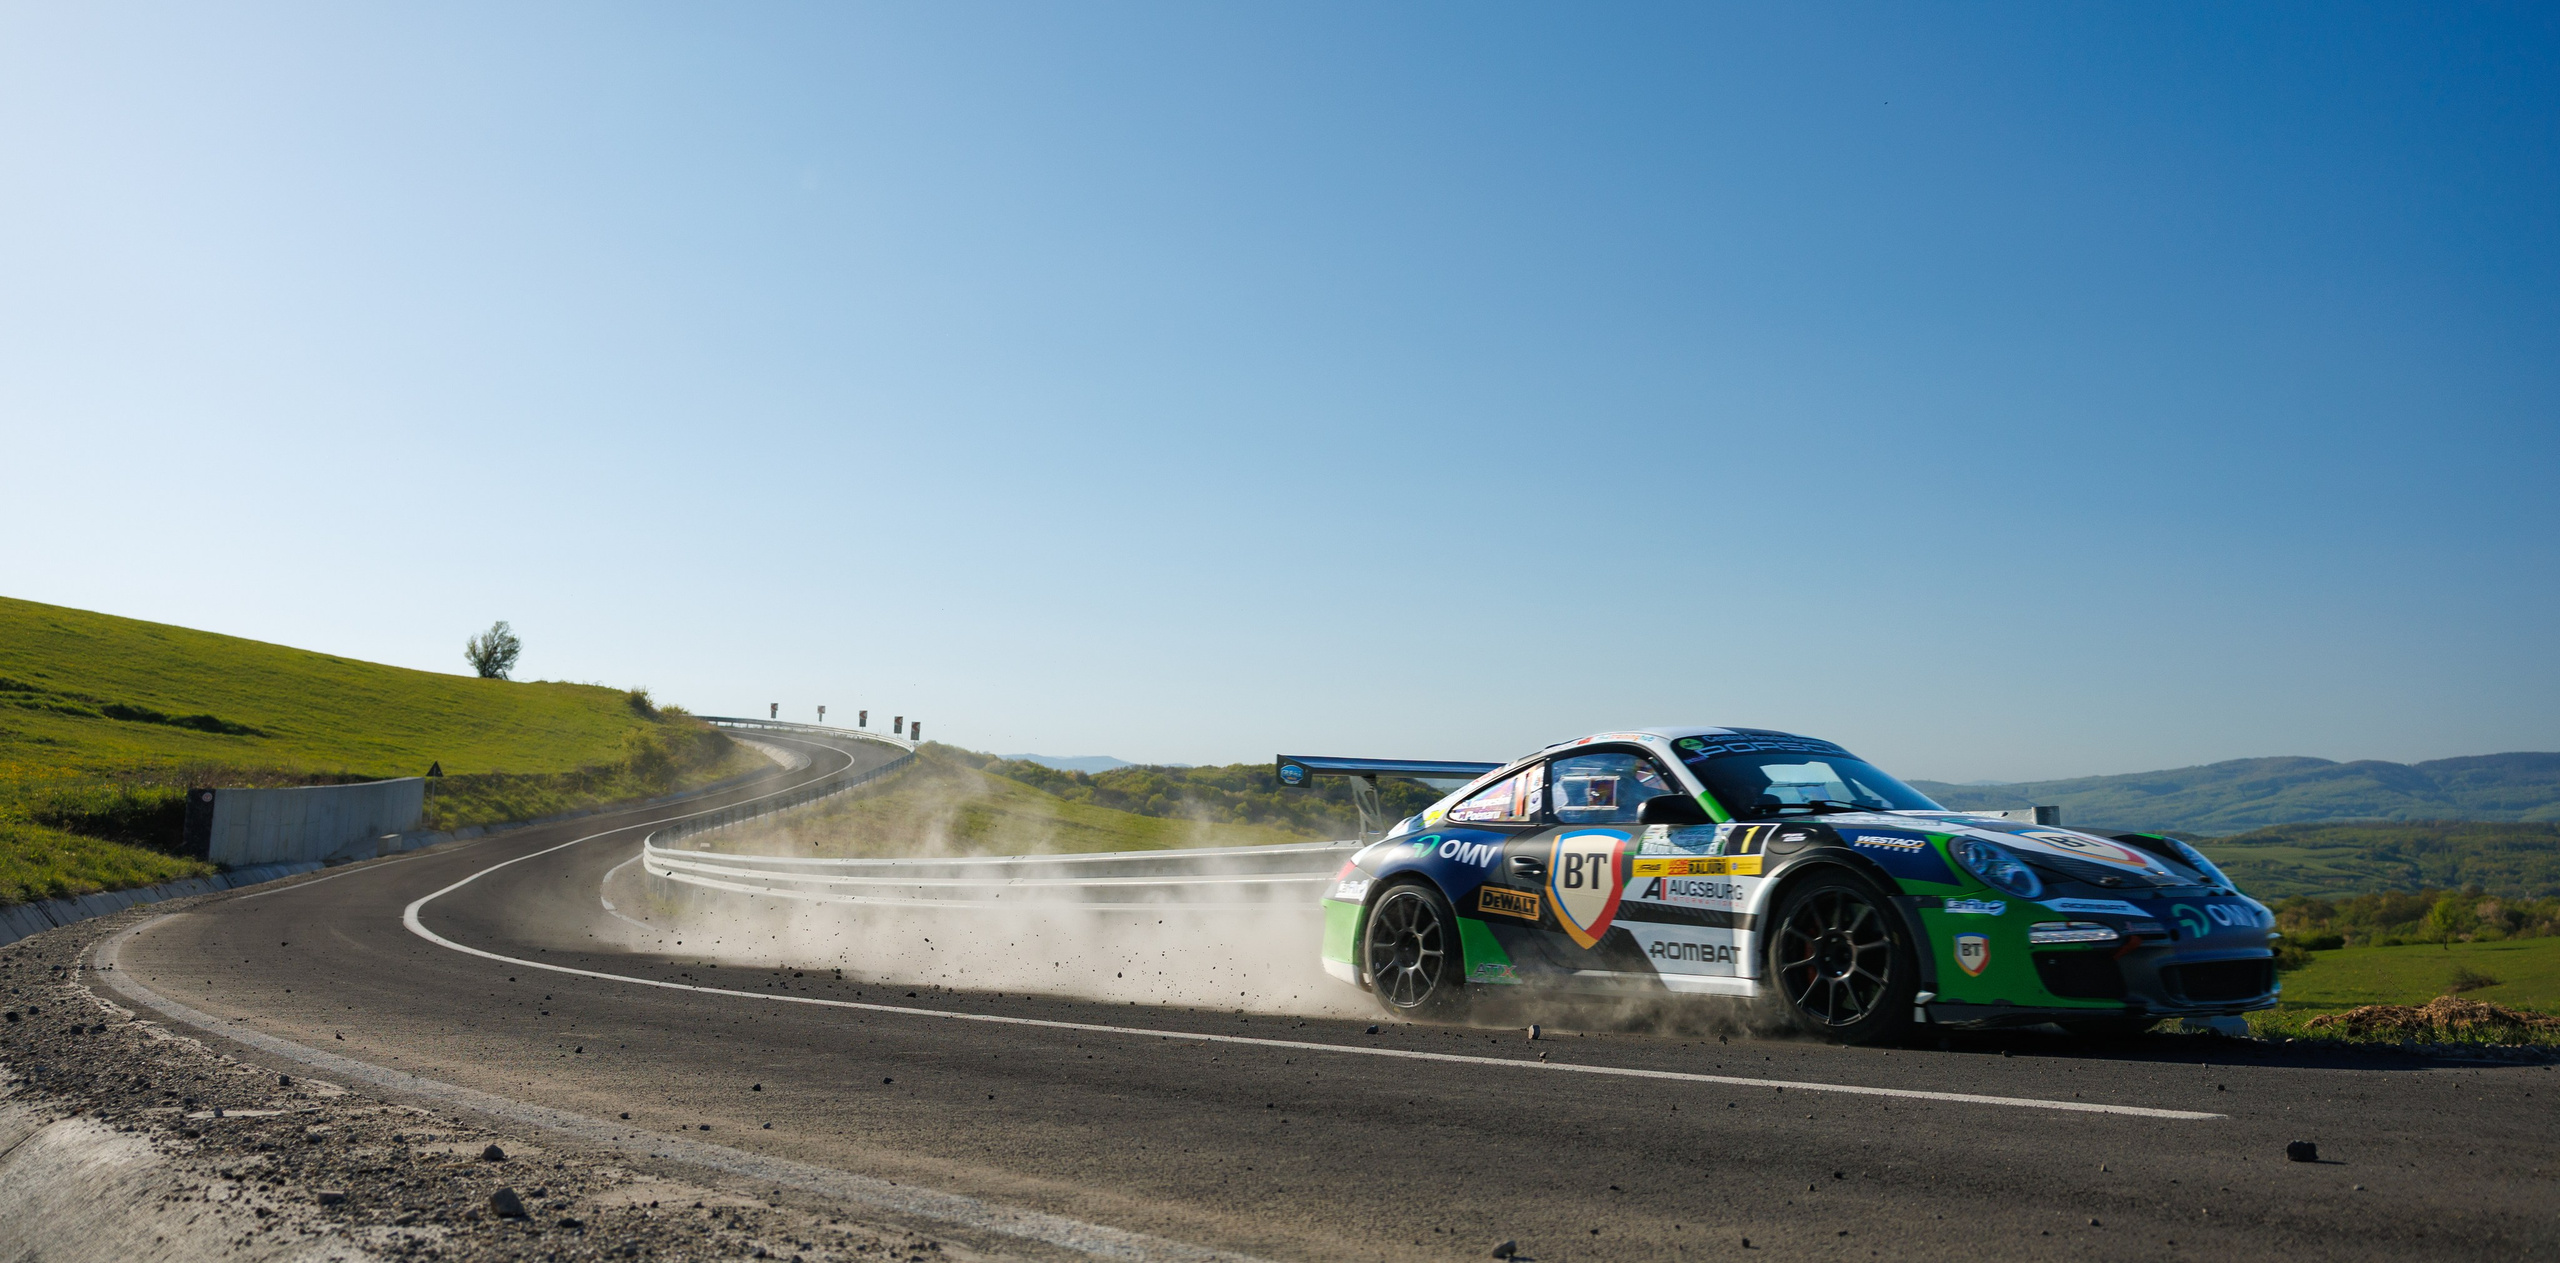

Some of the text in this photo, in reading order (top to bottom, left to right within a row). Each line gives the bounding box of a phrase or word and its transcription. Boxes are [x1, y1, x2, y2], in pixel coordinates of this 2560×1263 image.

[1740, 825, 1760, 854] 1
[1855, 835, 1926, 848] WESTACO
[2040, 836, 2103, 848] BT
[1439, 839, 1498, 868] OMV
[1564, 852, 1608, 890] BT
[1687, 862, 1727, 875] RALIURI
[1668, 879, 1744, 901] AUGSBURG
[2205, 904, 2261, 928] OMV
[1649, 941, 1742, 964] ROMBAT
[1961, 943, 1984, 957] BT
[1474, 963, 1518, 979] ATIX
